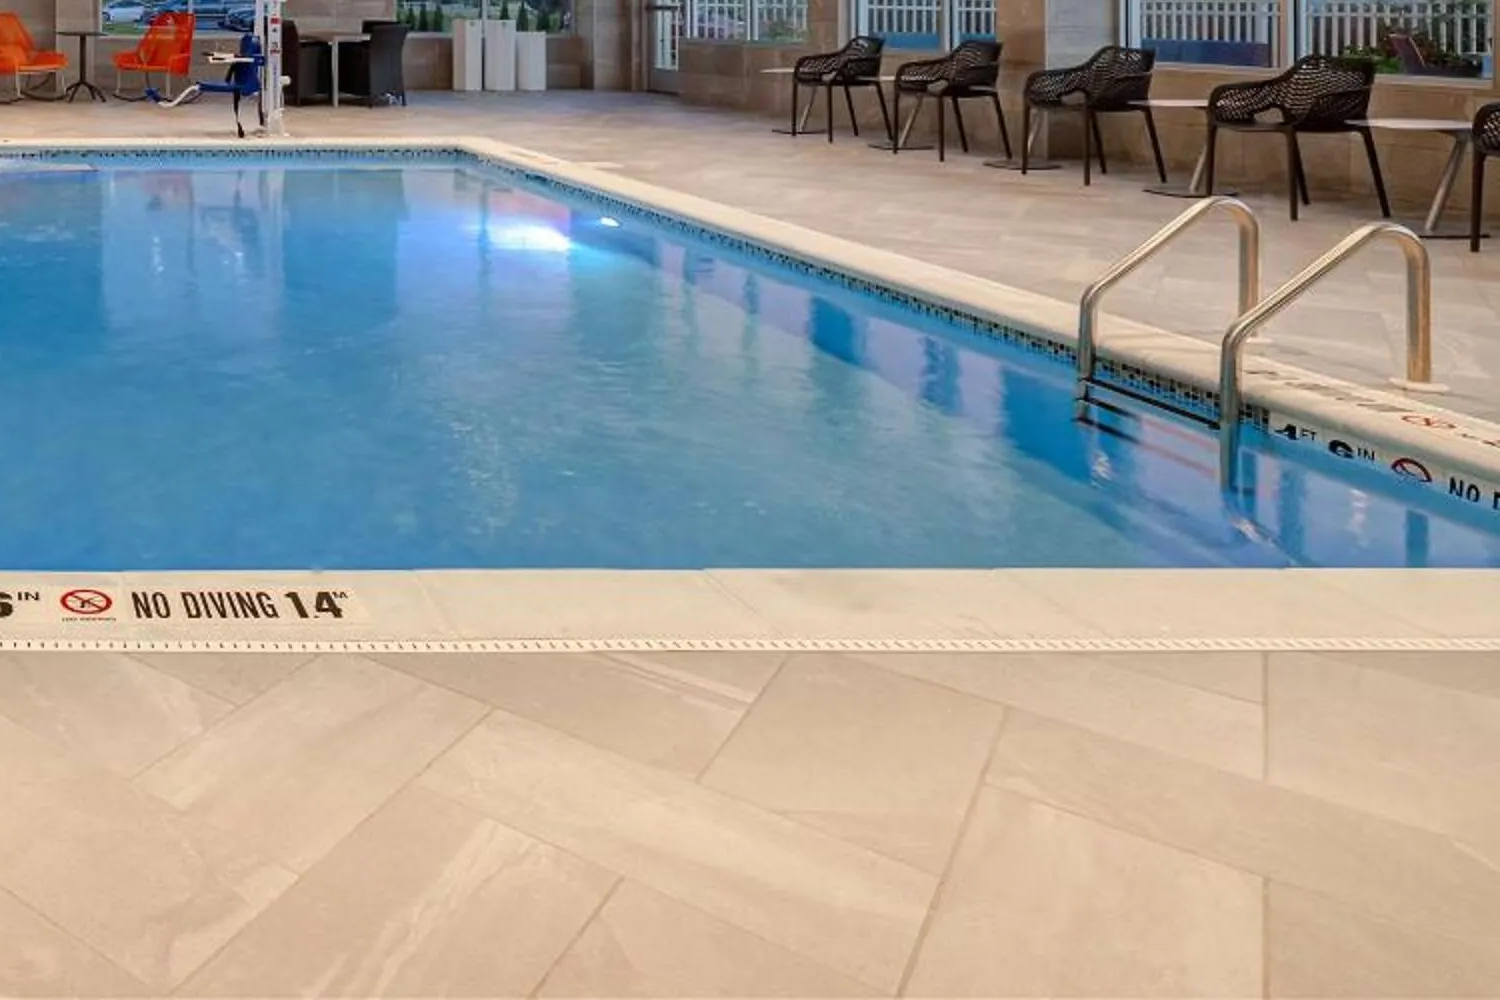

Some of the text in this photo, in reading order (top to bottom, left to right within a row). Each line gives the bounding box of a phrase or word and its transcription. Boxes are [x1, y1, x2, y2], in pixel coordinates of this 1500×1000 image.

[1449, 476, 1480, 502] NO
[131, 591, 171, 618] NO
[180, 591, 280, 618] DIVING
